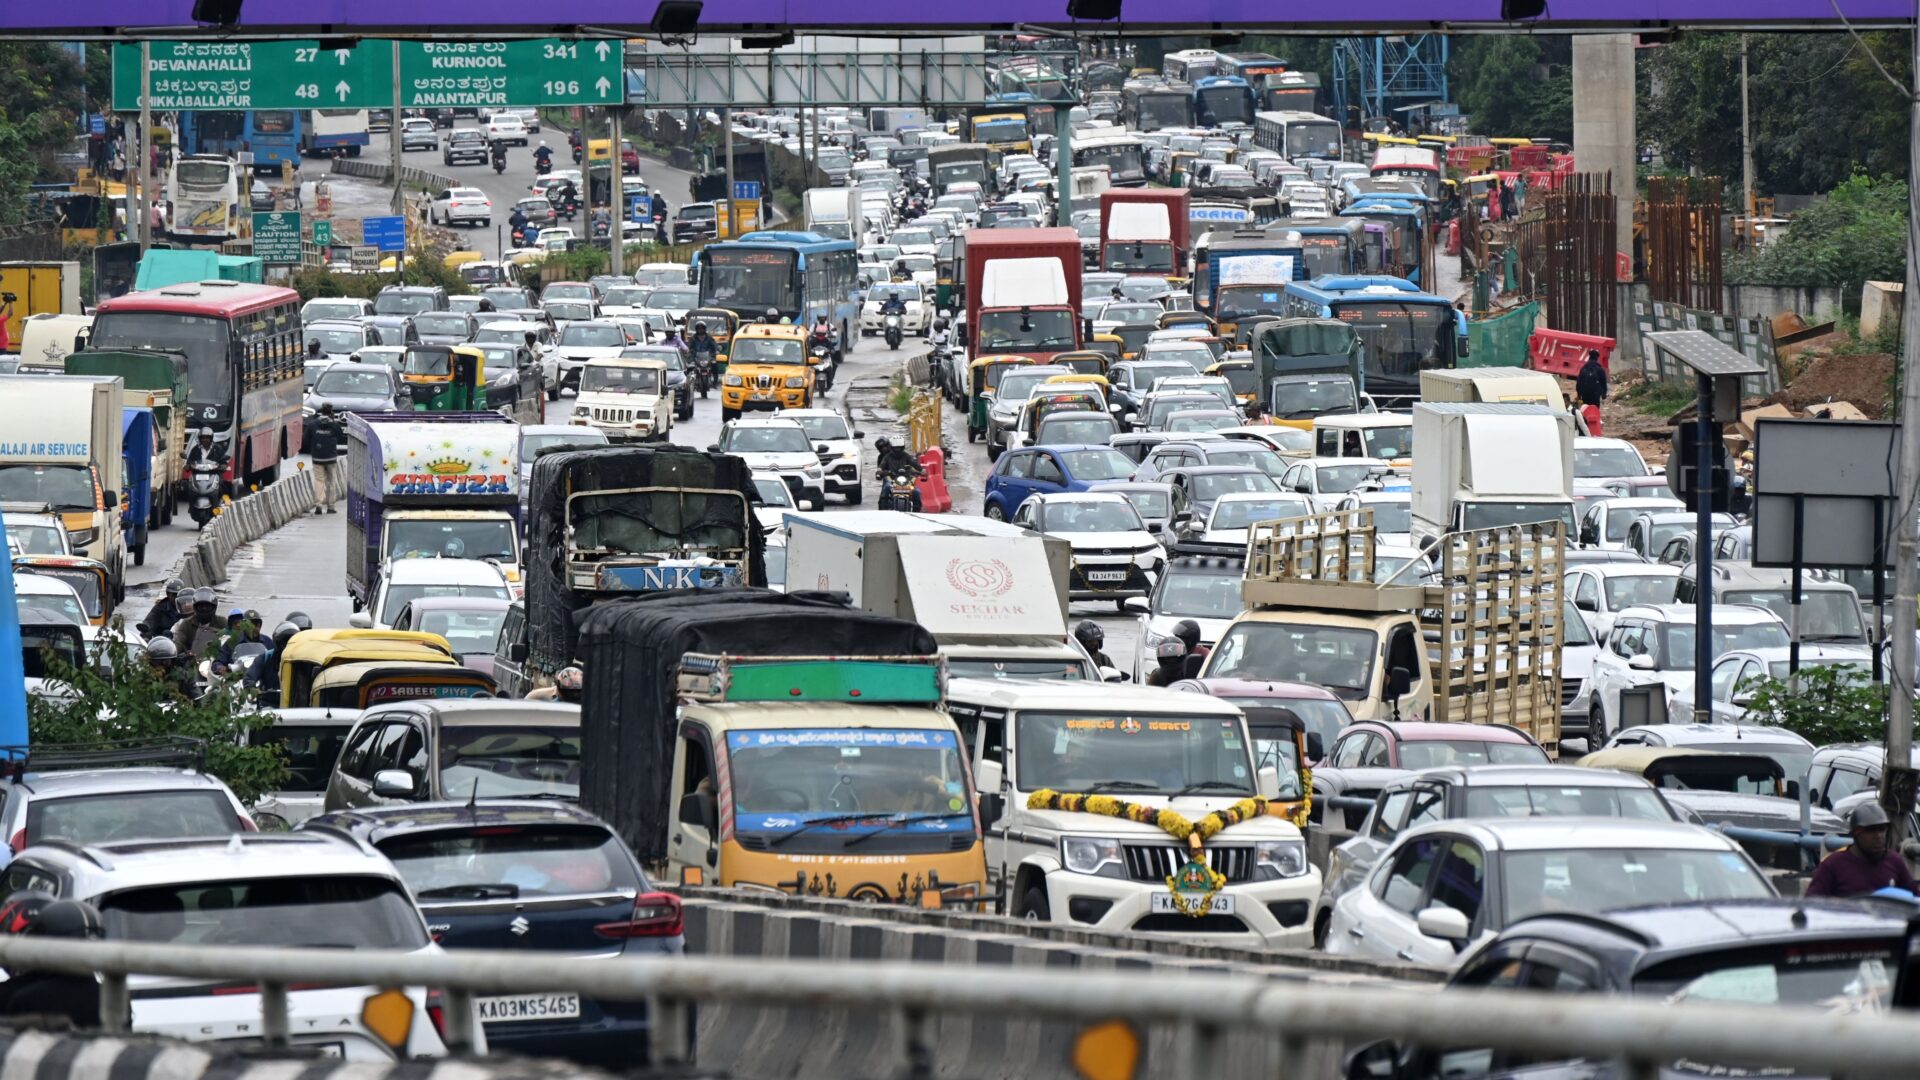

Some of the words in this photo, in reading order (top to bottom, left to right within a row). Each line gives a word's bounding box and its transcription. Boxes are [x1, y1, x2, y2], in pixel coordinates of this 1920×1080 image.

[295, 48, 318, 62] 27
[543, 45, 577, 59] 341
[149, 59, 250, 71] DEVANAHALLI
[432, 56, 506, 68] KURNOOL
[295, 84, 319, 98] 48
[543, 81, 579, 95] 196
[413, 92, 507, 105] ANANTAPUR
[316, 233, 328, 242] 43
[0, 443, 28, 456] ALAJI
[30, 443, 46, 456] AIR
[48, 443, 88, 456] SERVICE
[390, 474, 510, 493] HAFIZA
[642, 567, 696, 590] N.K
[950, 604, 1025, 614] SEKHAR
[391, 687, 437, 697] SABEER
[442, 687, 469, 697] PIYA
[480, 996, 577, 1018] KA03NS5465
[201, 1018, 352, 1034] CRTA
